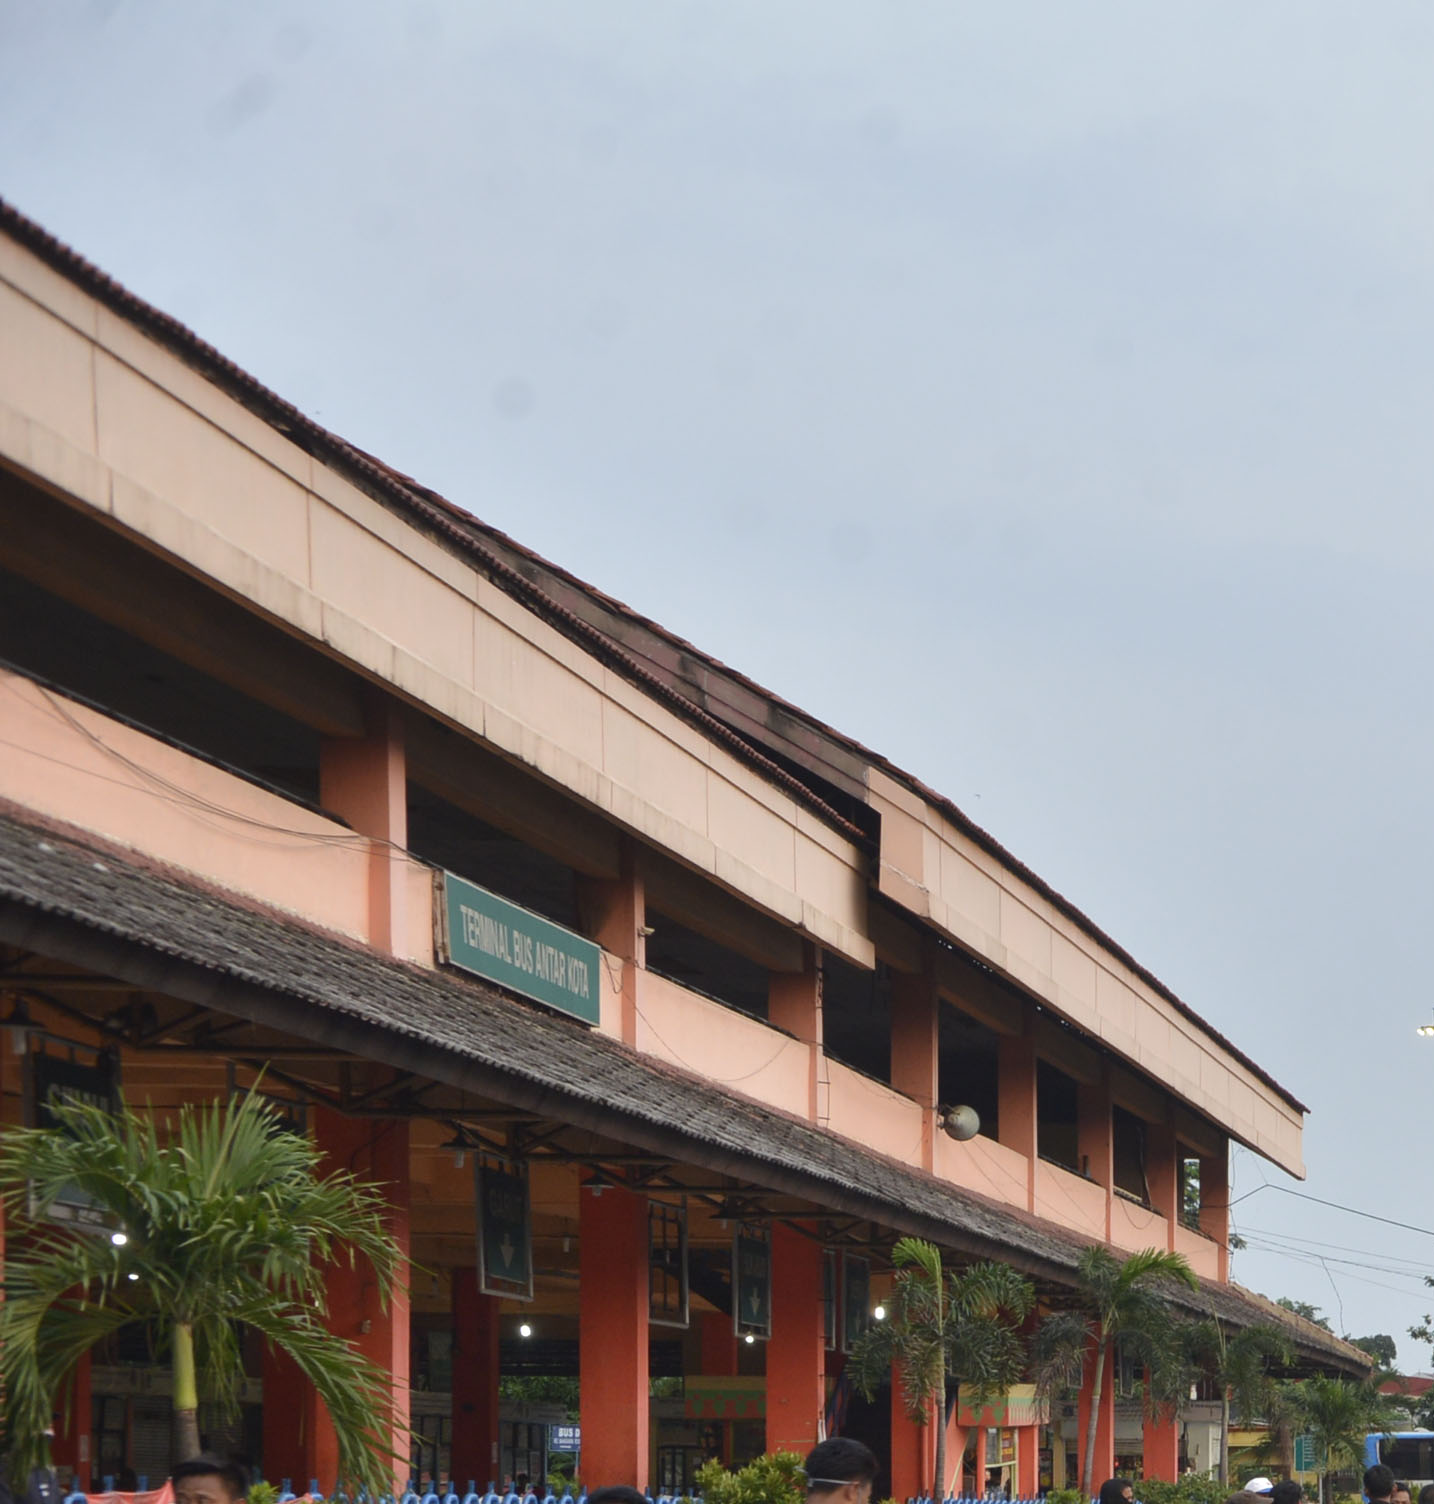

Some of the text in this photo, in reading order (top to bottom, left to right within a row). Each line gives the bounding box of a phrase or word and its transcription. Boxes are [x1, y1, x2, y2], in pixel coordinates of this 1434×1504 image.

[460, 904, 590, 1000] TERMINAL BUS ANTAR KOTA
[558, 1427, 573, 1437] BUS
